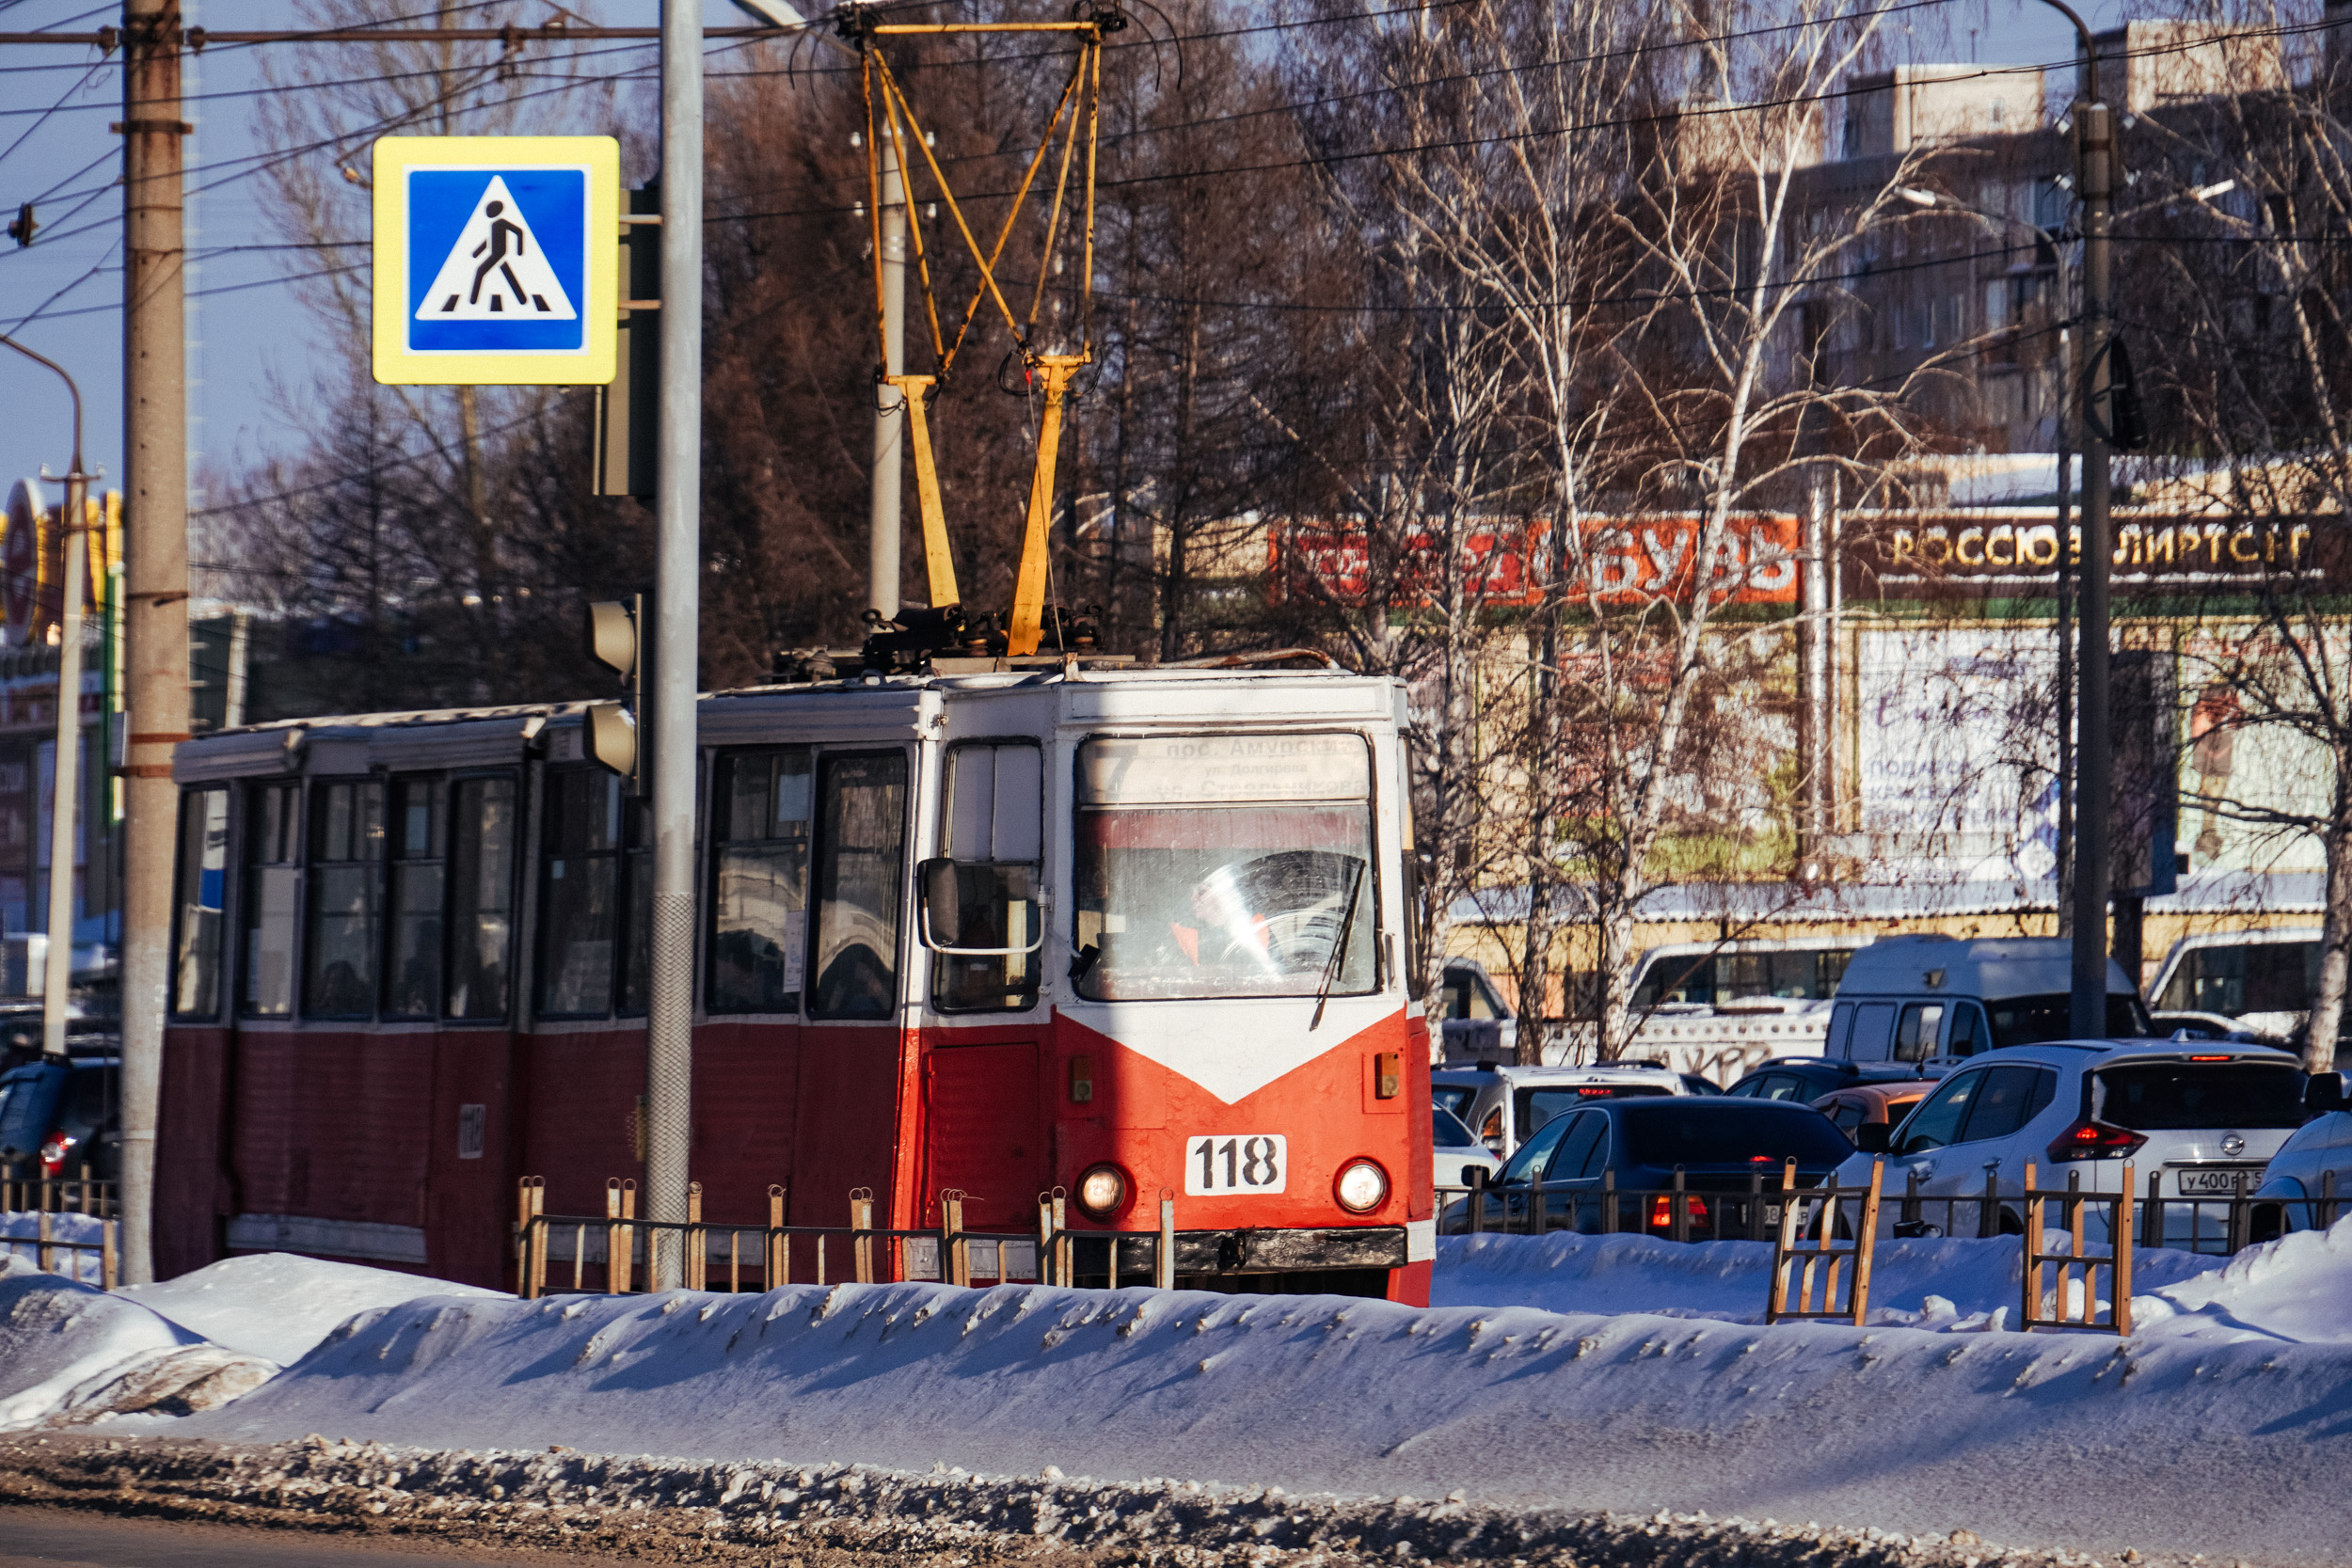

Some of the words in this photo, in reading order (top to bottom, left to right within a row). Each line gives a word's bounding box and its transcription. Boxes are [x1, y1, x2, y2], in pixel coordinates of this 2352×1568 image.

[1893, 526, 2311, 565] РОССЮВЛИРТОРГ
[1095, 745, 1139, 800] 7
[1195, 1137, 1278, 1188] 118
